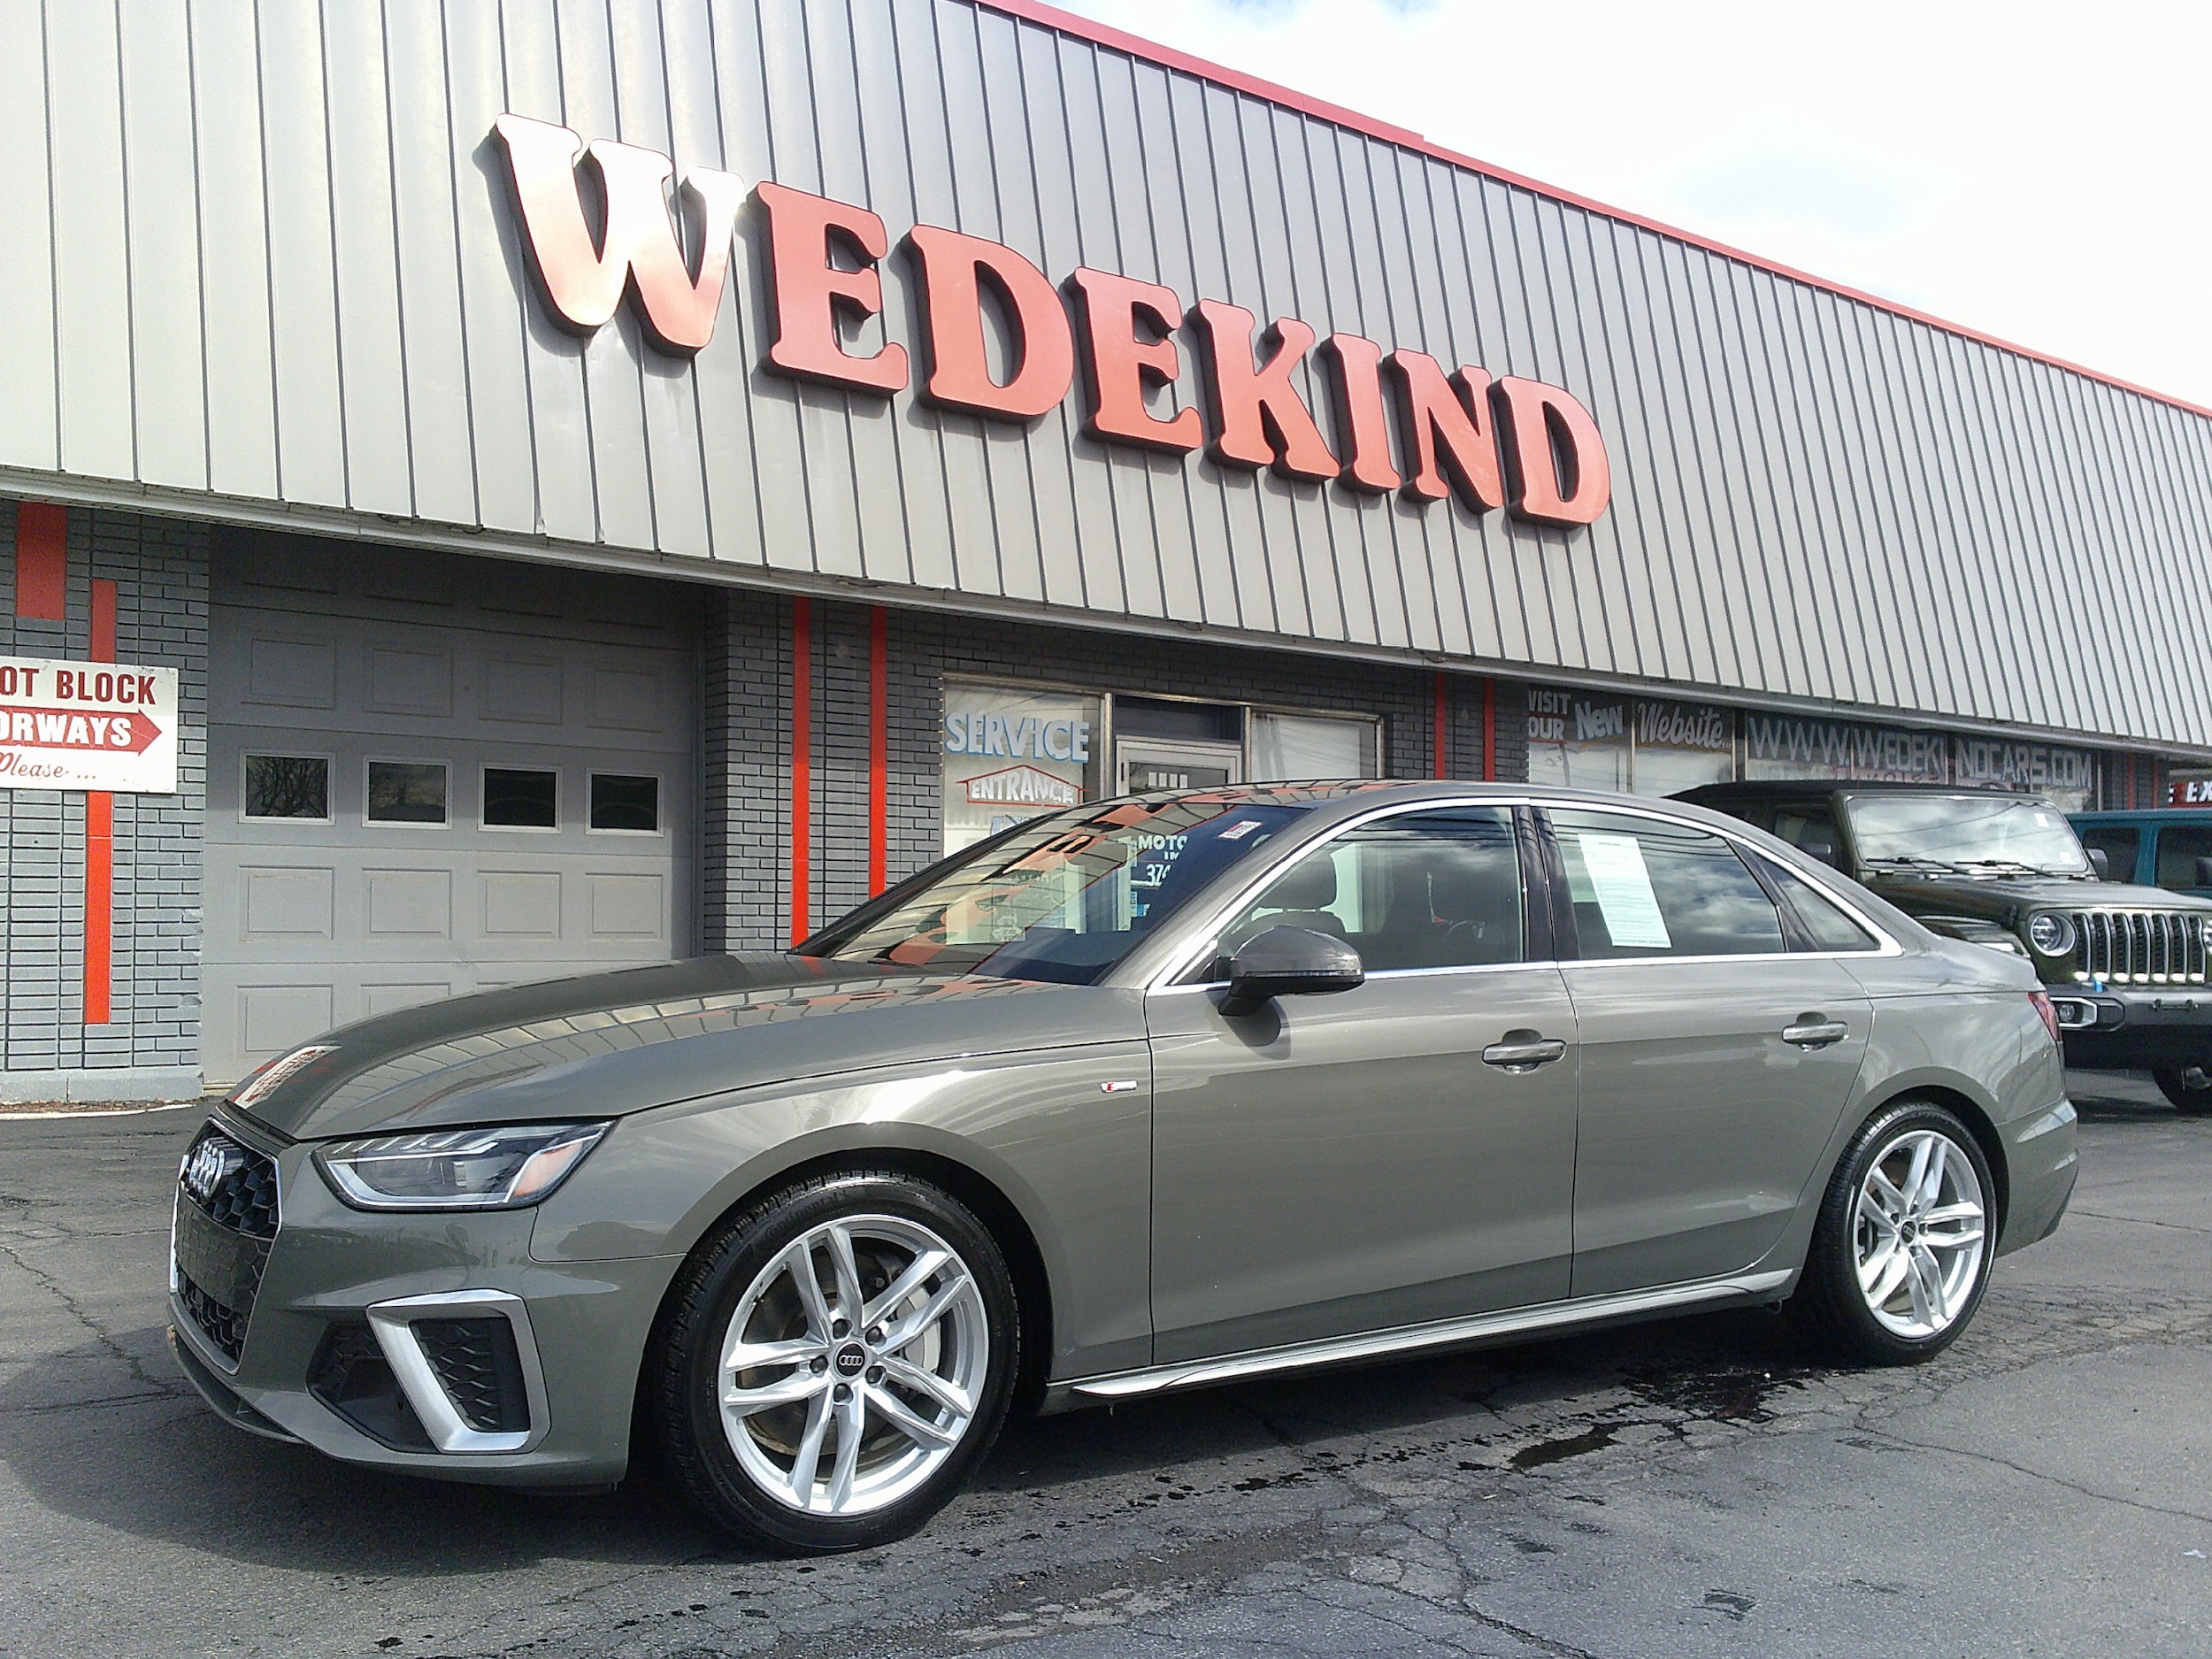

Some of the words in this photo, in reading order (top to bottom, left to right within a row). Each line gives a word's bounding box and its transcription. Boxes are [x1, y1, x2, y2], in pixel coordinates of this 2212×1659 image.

[490, 112, 1612, 531] WEDEKIND
[56, 670, 157, 705] BLOCK
[1528, 689, 1571, 715] VISIT
[944, 713, 1090, 764] SERVICE
[1528, 717, 1564, 741] OUR
[971, 768, 1074, 803] ENTRANCE
